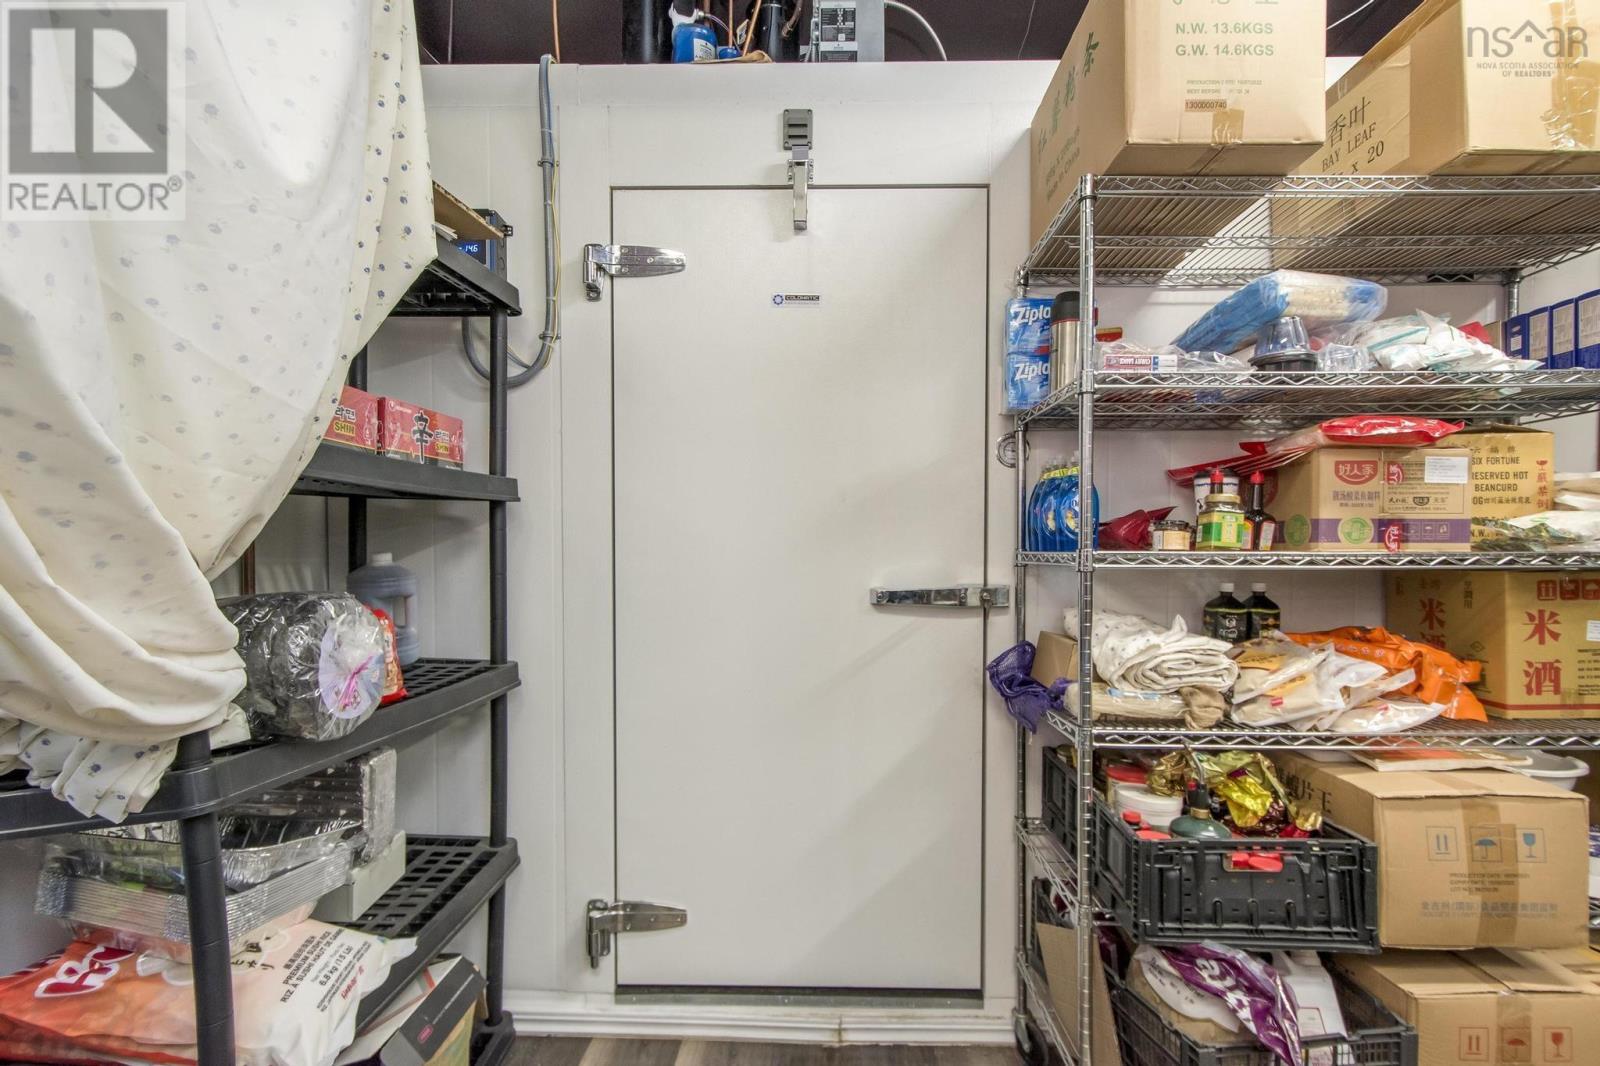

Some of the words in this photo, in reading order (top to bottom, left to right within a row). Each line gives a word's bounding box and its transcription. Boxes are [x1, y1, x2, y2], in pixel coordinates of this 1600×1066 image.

[1175, 23, 1208, 34] N.W.
[1213, 23, 1273, 34] 13.6KGS
[1175, 45, 1208, 56] G.W.
[1213, 45, 1274, 56] 14.6KGS
[1327, 96, 1371, 148] 香叶
[1322, 147, 1341, 172] BAY
[1347, 121, 1376, 153] LEAF
[1367, 140, 1384, 164] 20
[334, 421, 355, 437] SHIN
[1486, 457, 1520, 465] FORTUNE
[1475, 484, 1518, 492] BEANCURD
[1522, 609, 1562, 696] 米酒
[282, 955, 310, 986] PREMIUM
[306, 939, 323, 956] SUSHI
[280, 988, 294, 1004] RIZ
[296, 961, 315, 983] SUSHI
[311, 946, 327, 963] HAUT
[318, 973, 332, 987] 6.8
[327, 964, 339, 976] kg
